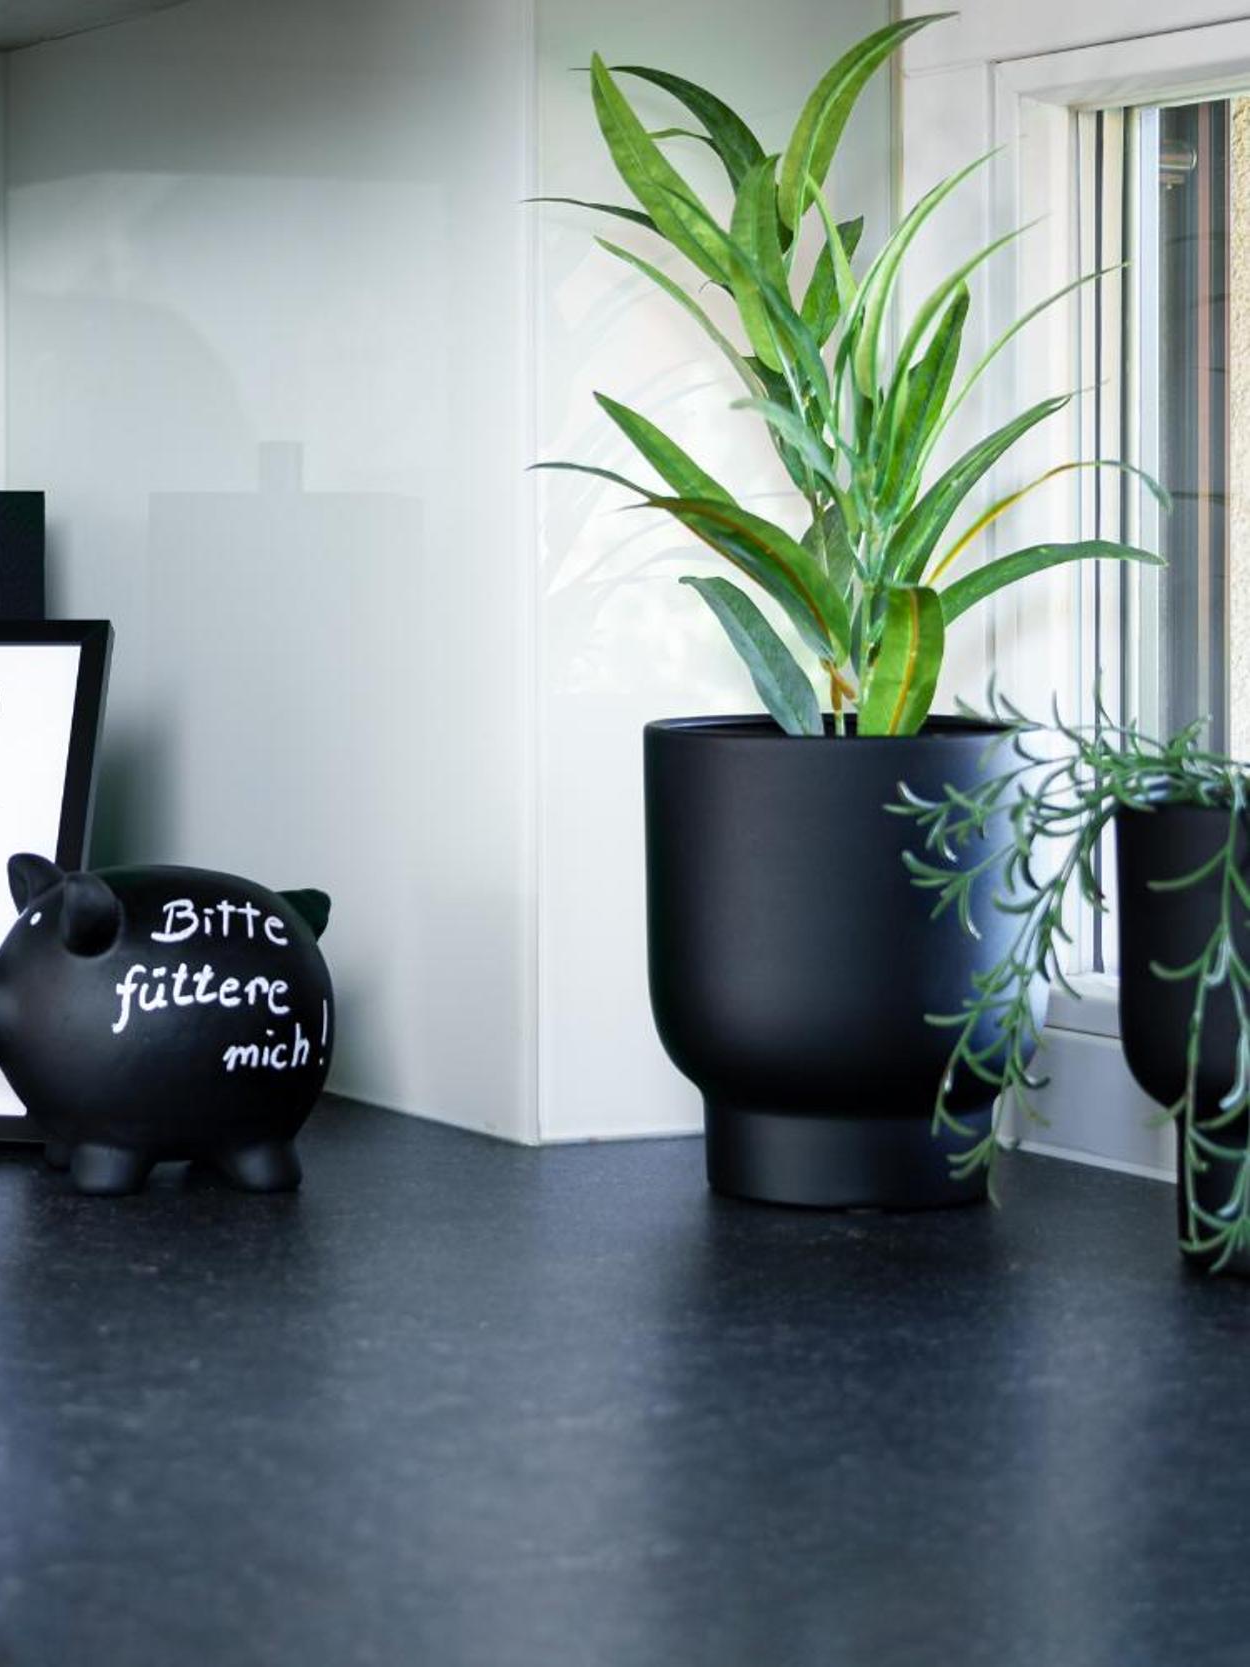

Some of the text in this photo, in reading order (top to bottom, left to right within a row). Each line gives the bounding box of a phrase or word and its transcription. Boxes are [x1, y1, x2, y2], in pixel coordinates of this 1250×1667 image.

[150, 898, 289, 946] Bitte
[111, 962, 291, 1034] füttere
[222, 999, 328, 1072] mich!
